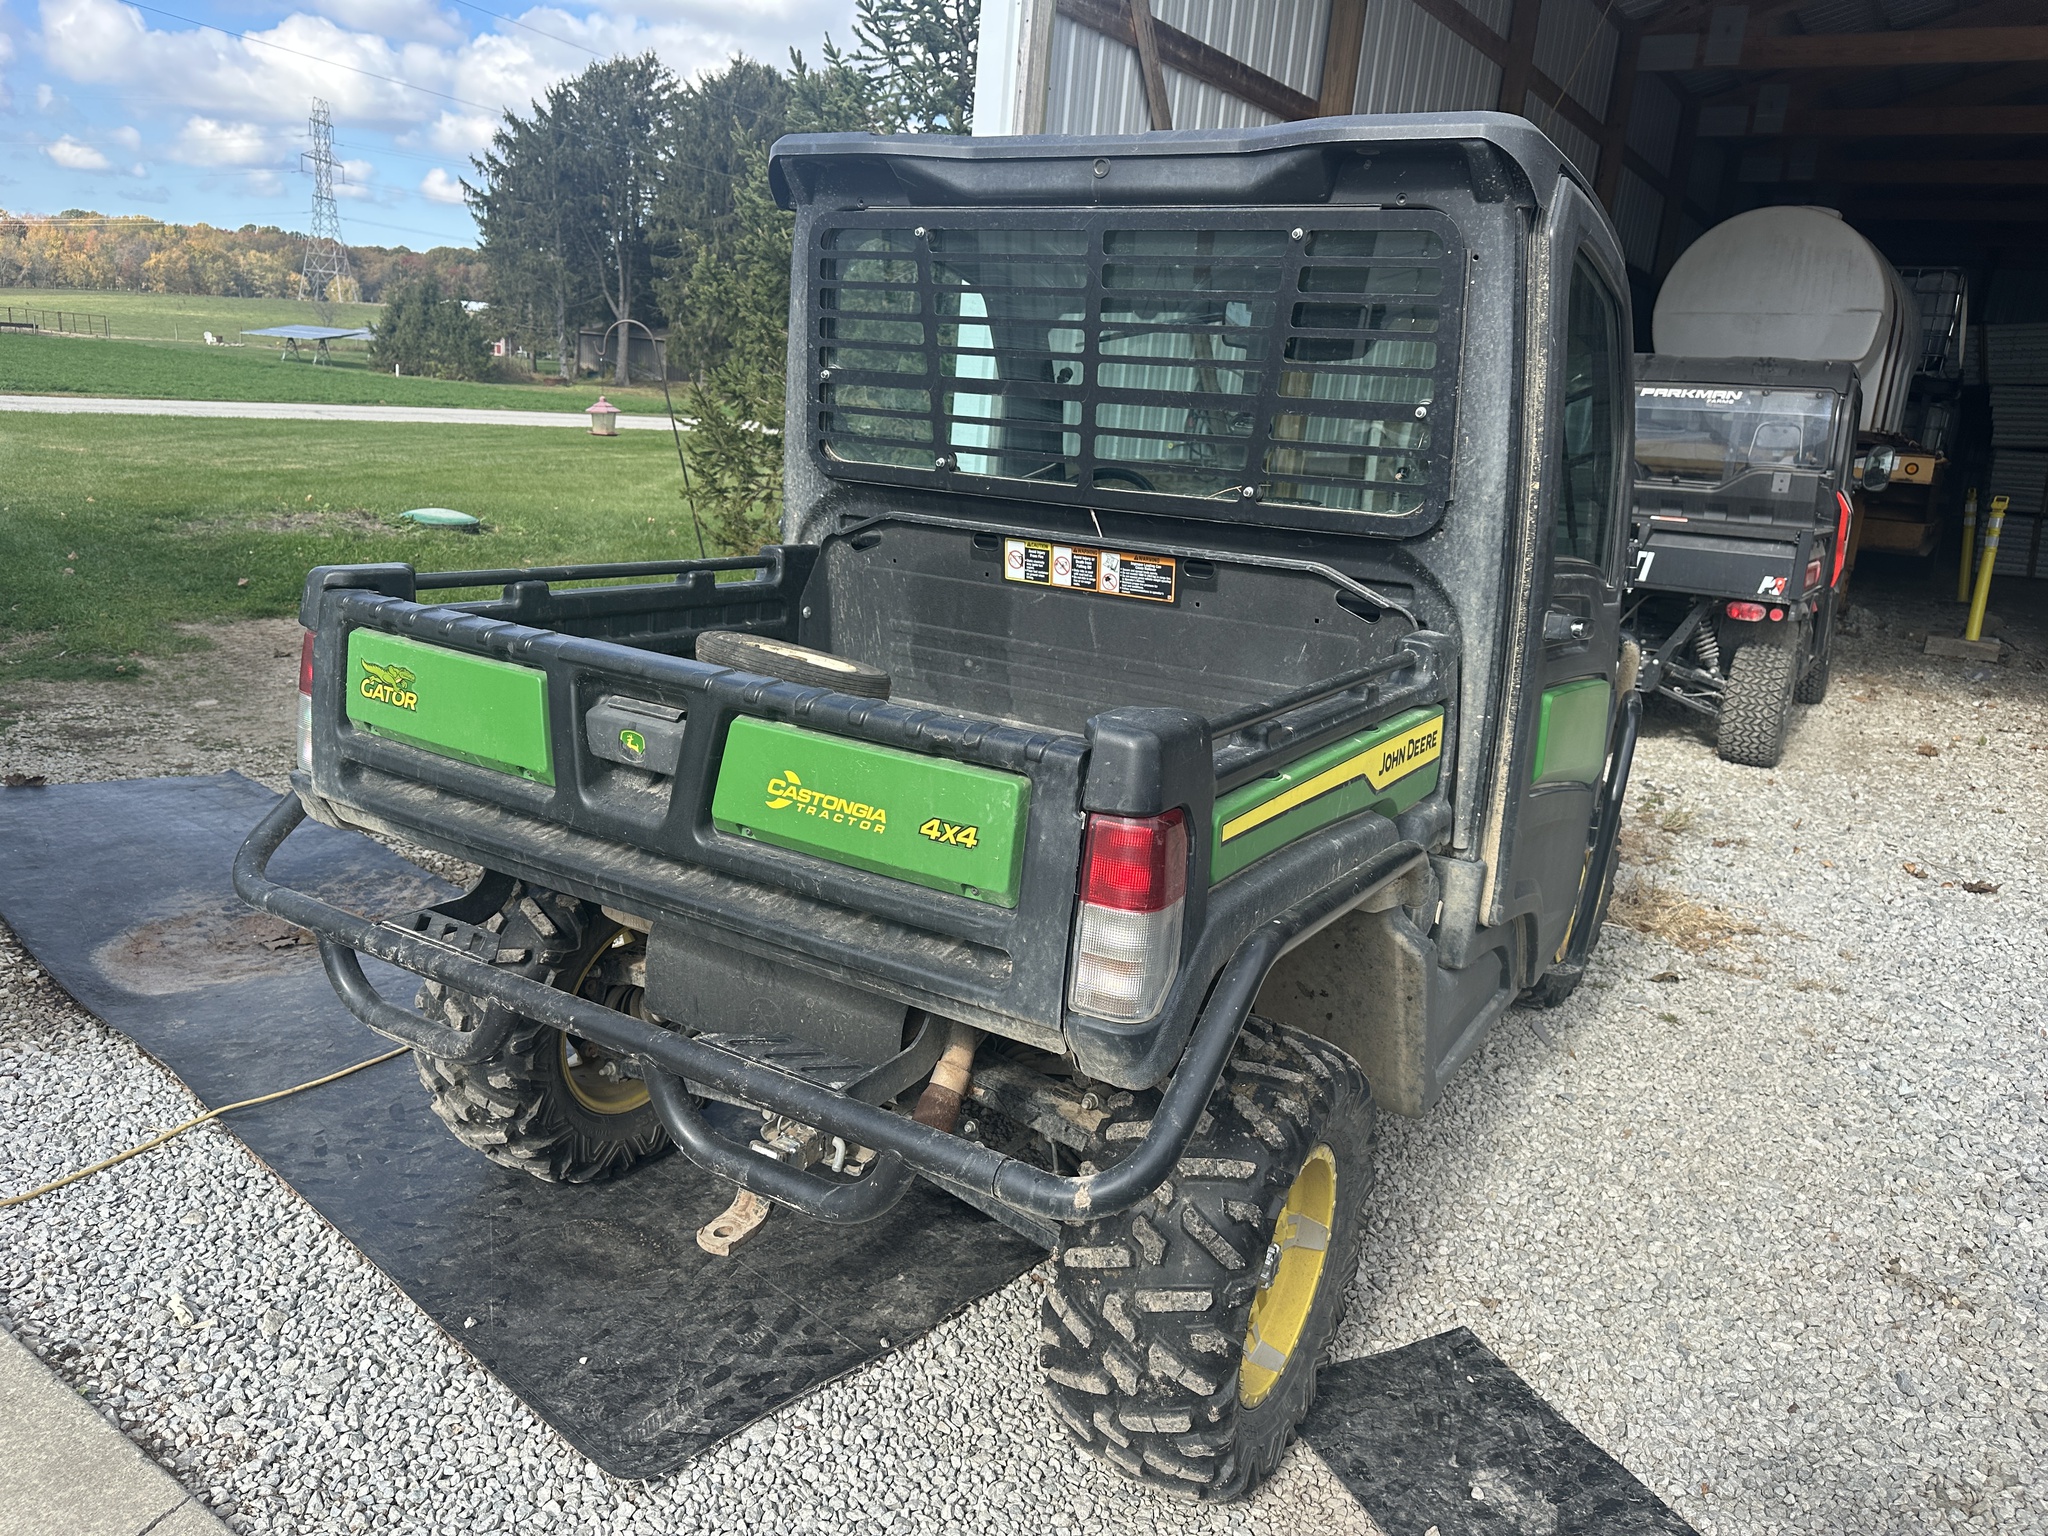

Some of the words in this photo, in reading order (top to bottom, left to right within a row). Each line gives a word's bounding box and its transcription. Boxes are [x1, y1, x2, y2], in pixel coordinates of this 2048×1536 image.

[1640, 387, 1743, 400] PARKMAN
[1138, 555, 1160, 563] WARNING
[360, 678, 418, 711] GATOR
[1378, 745, 1406, 777] JOHN
[1406, 730, 1438, 760] DEERE
[767, 777, 887, 824] CASTONGIA
[796, 803, 886, 834] TRACTOR
